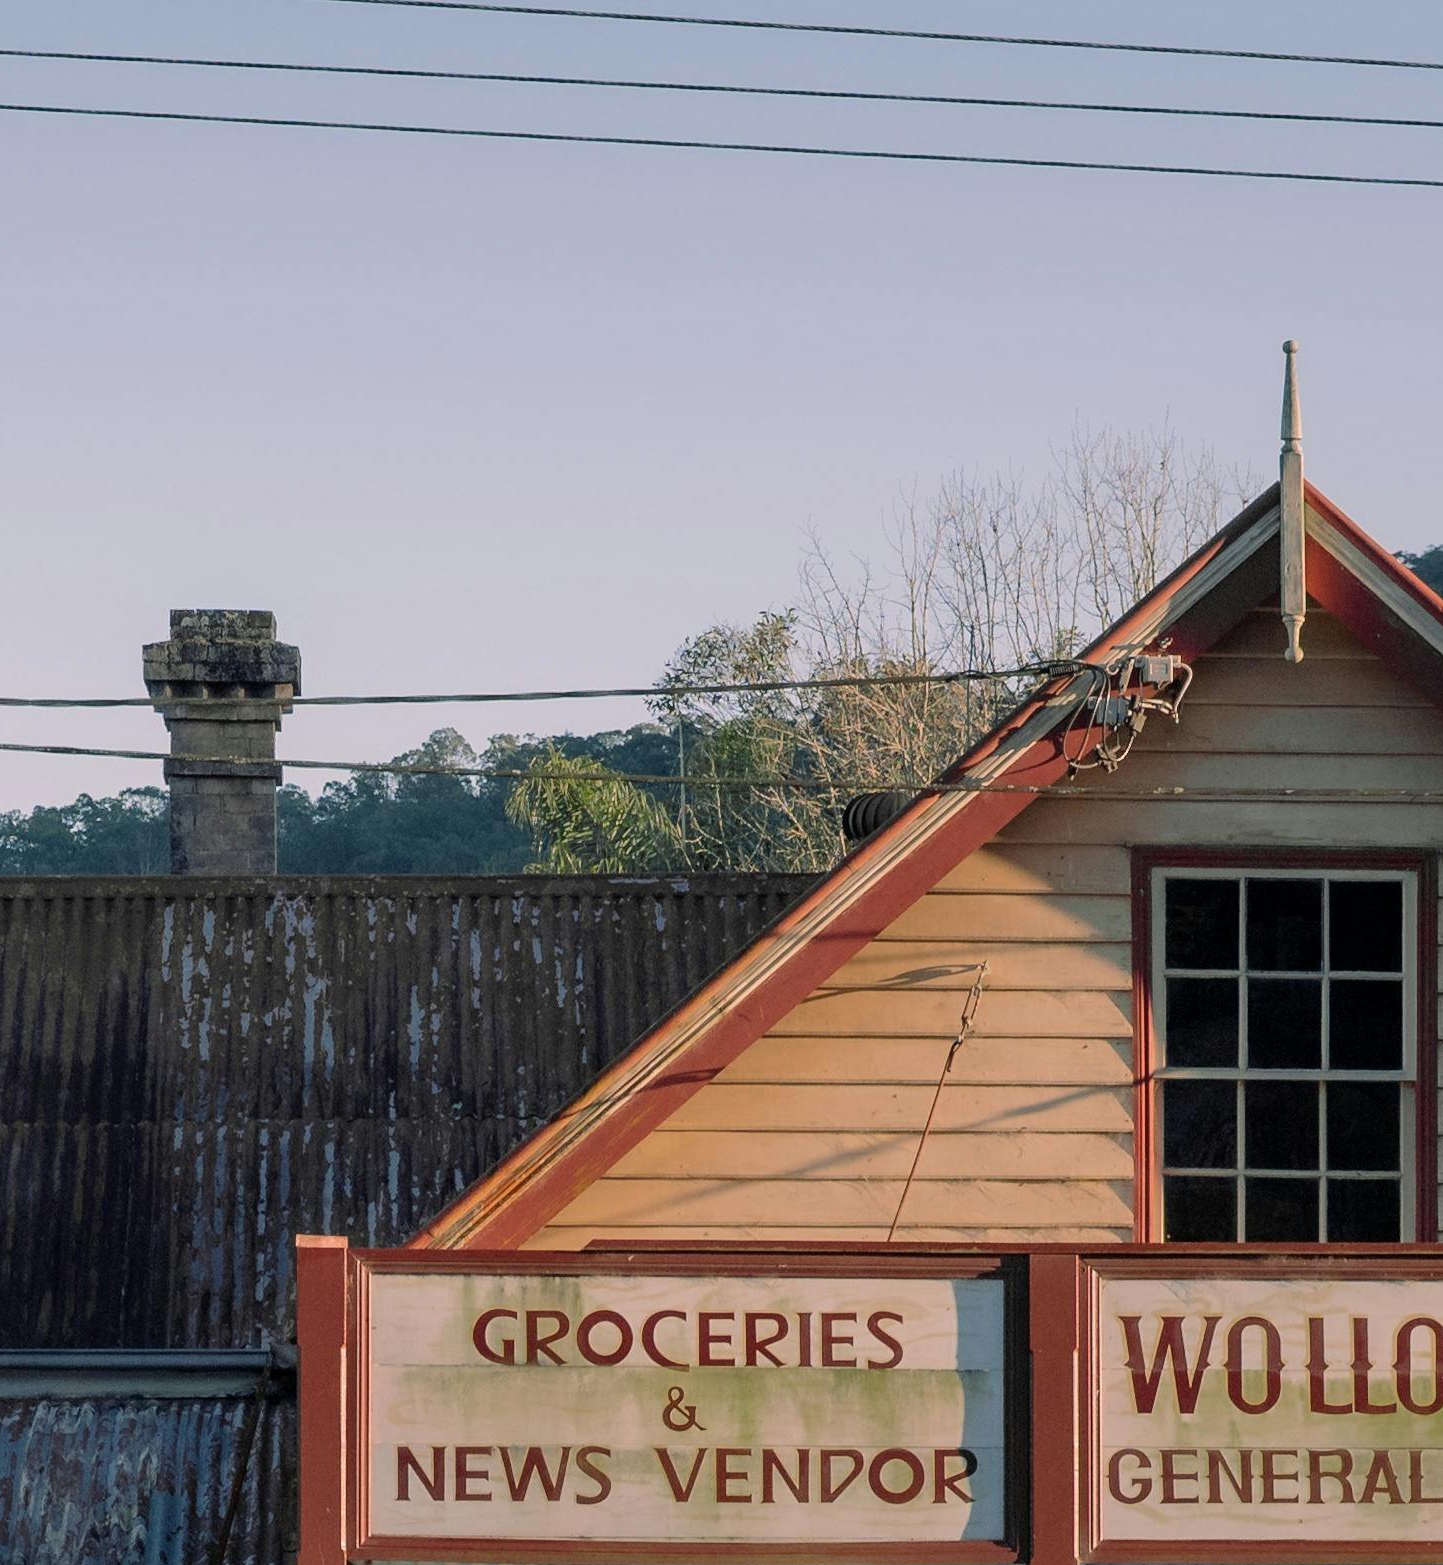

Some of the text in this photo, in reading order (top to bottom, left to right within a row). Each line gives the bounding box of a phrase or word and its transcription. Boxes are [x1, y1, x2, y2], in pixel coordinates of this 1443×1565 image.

[472, 1307, 905, 1372] GROCERIES
[662, 1385, 707, 1432] &
[395, 1445, 979, 1506] NEWS VENDOR
